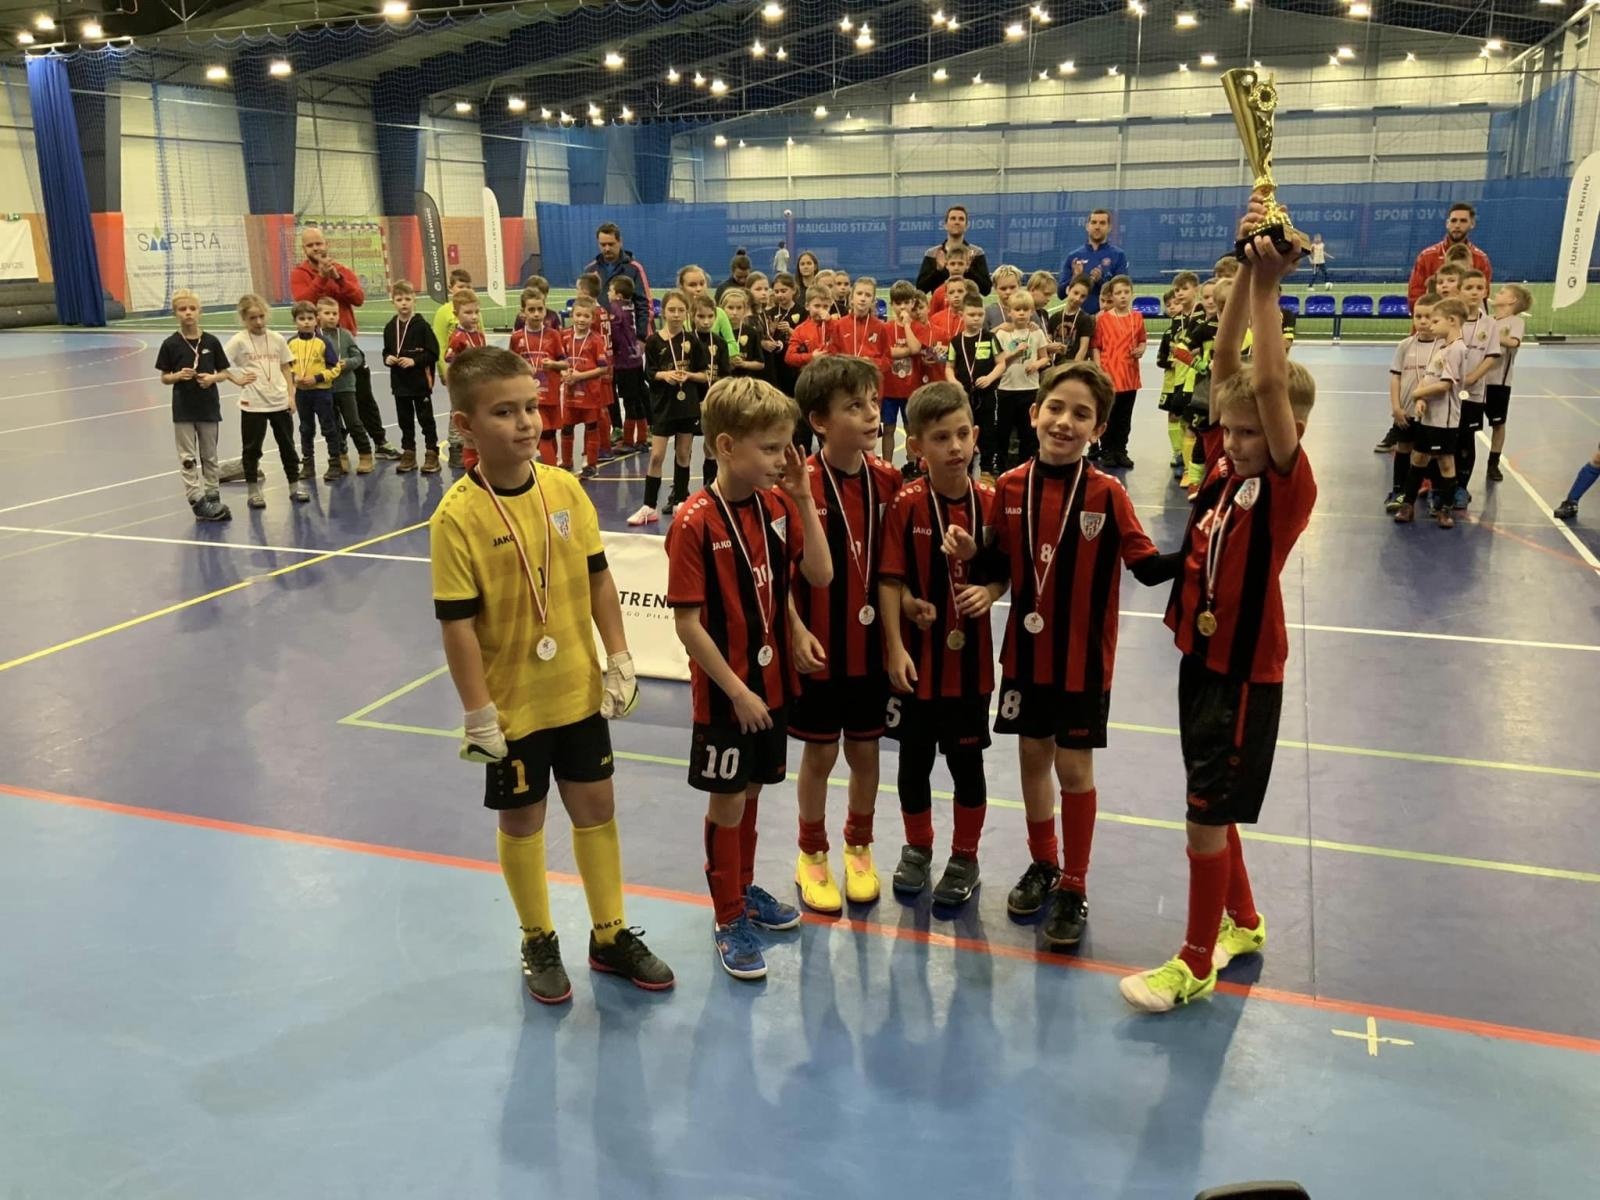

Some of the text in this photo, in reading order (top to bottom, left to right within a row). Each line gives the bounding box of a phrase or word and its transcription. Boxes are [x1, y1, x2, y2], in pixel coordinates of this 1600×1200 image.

[1570, 175, 1591, 266] JUNIOR TRENING
[1005, 507, 1022, 515] JAKO
[913, 527, 932, 536] JAKO
[712, 540, 731, 550] JAKO
[1041, 543, 1052, 562] 8
[619, 590, 671, 609] TREN
[886, 696, 901, 728] 5
[1001, 689, 1022, 720] 8
[701, 745, 740, 780] 10
[511, 759, 530, 794] 1
